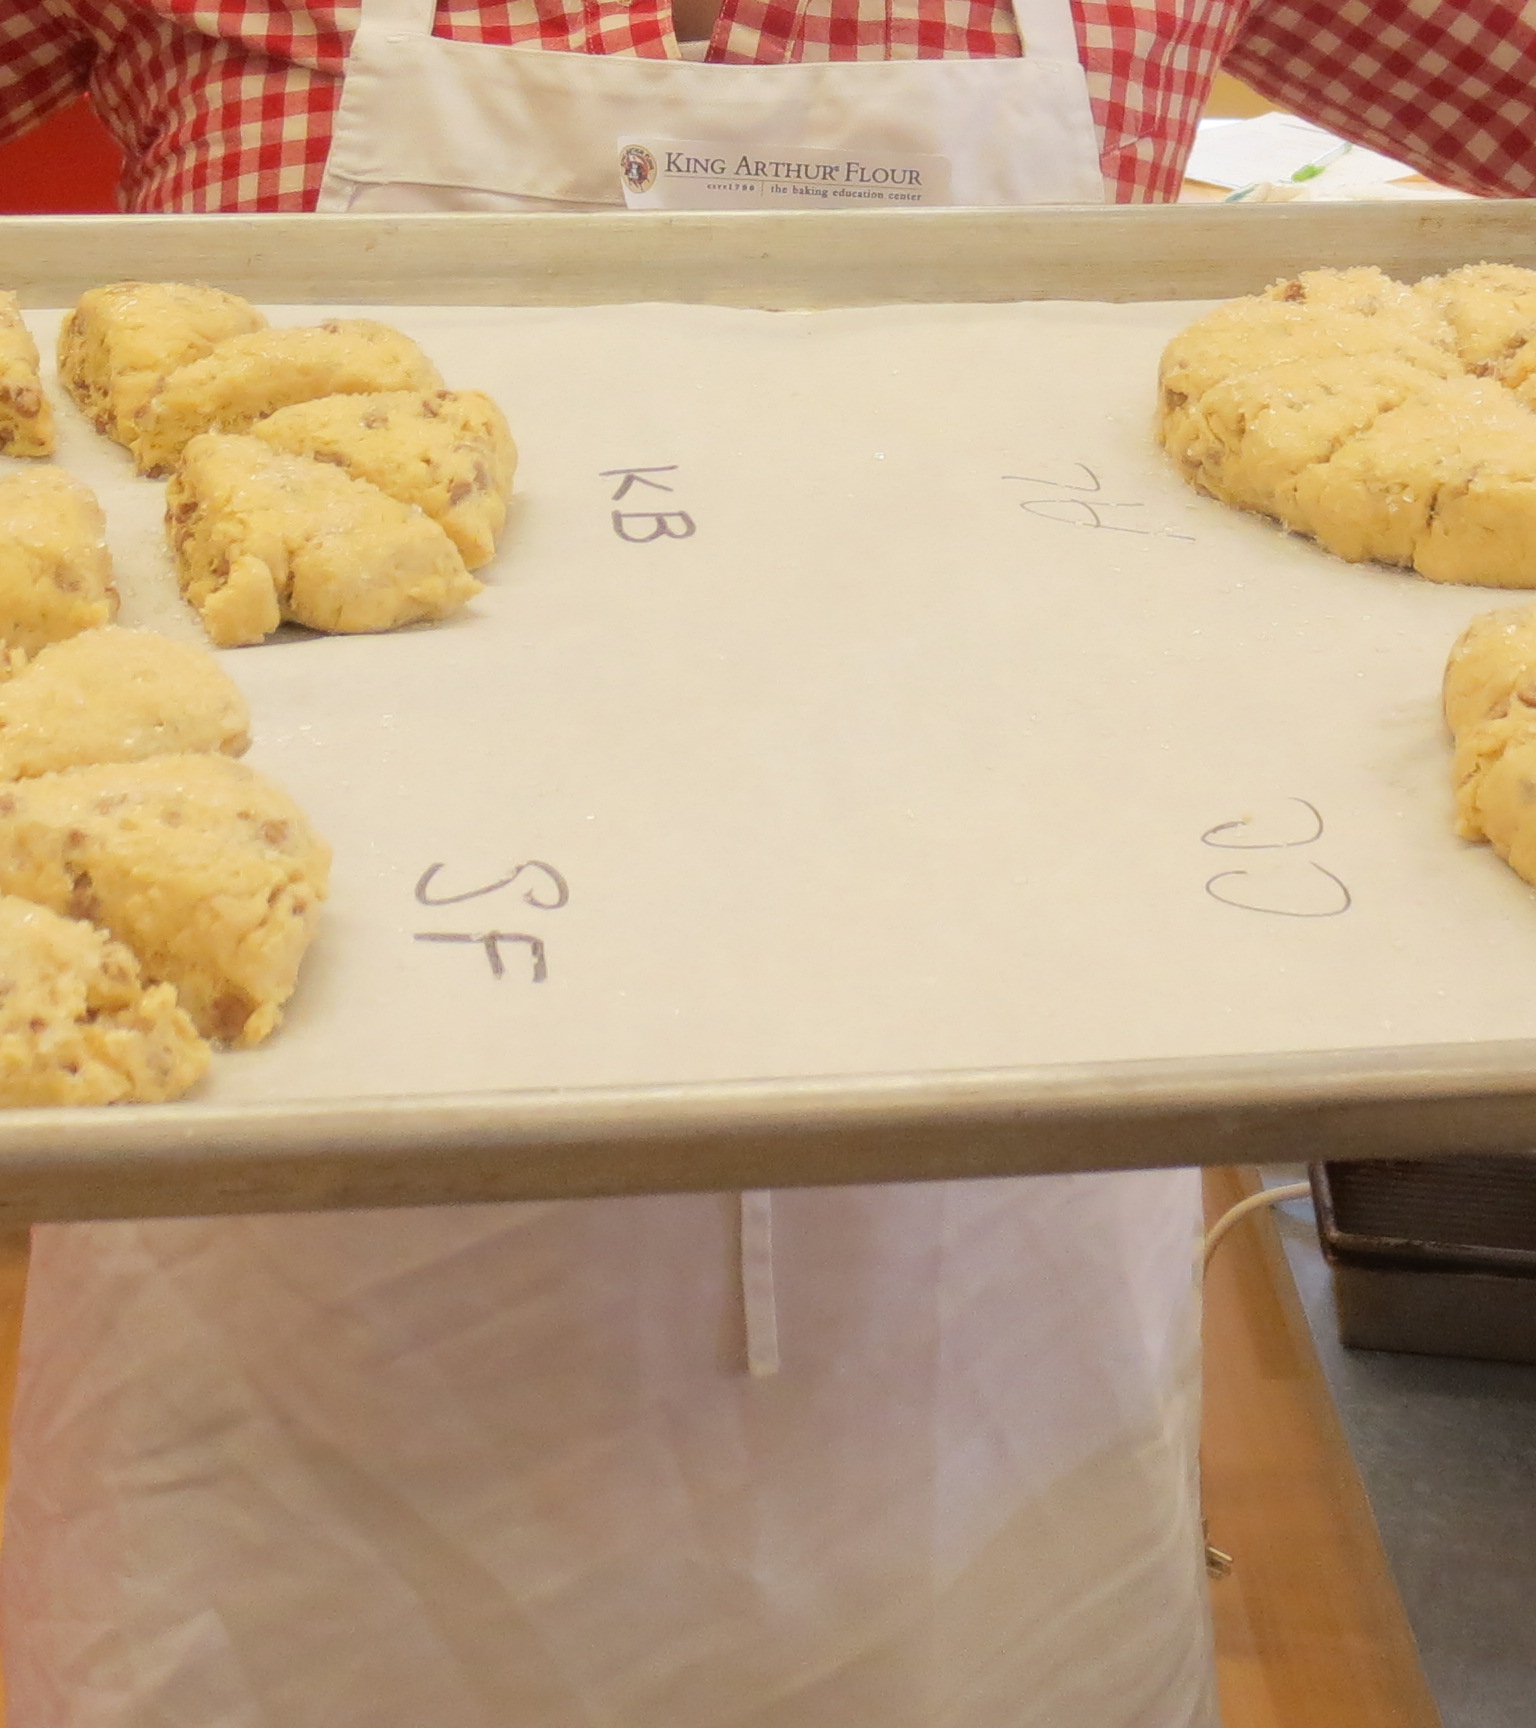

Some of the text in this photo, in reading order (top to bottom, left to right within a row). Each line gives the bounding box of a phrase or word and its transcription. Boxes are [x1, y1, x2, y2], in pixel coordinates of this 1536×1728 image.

[664, 152, 726, 175] KING
[844, 161, 923, 186] FLOUR
[770, 184, 788, 194] the
[792, 185, 829, 199] baking
[832, 188, 884, 200] education
[888, 191, 922, 202] center
[598, 464, 697, 543] KB
[412, 859, 570, 984] SF
